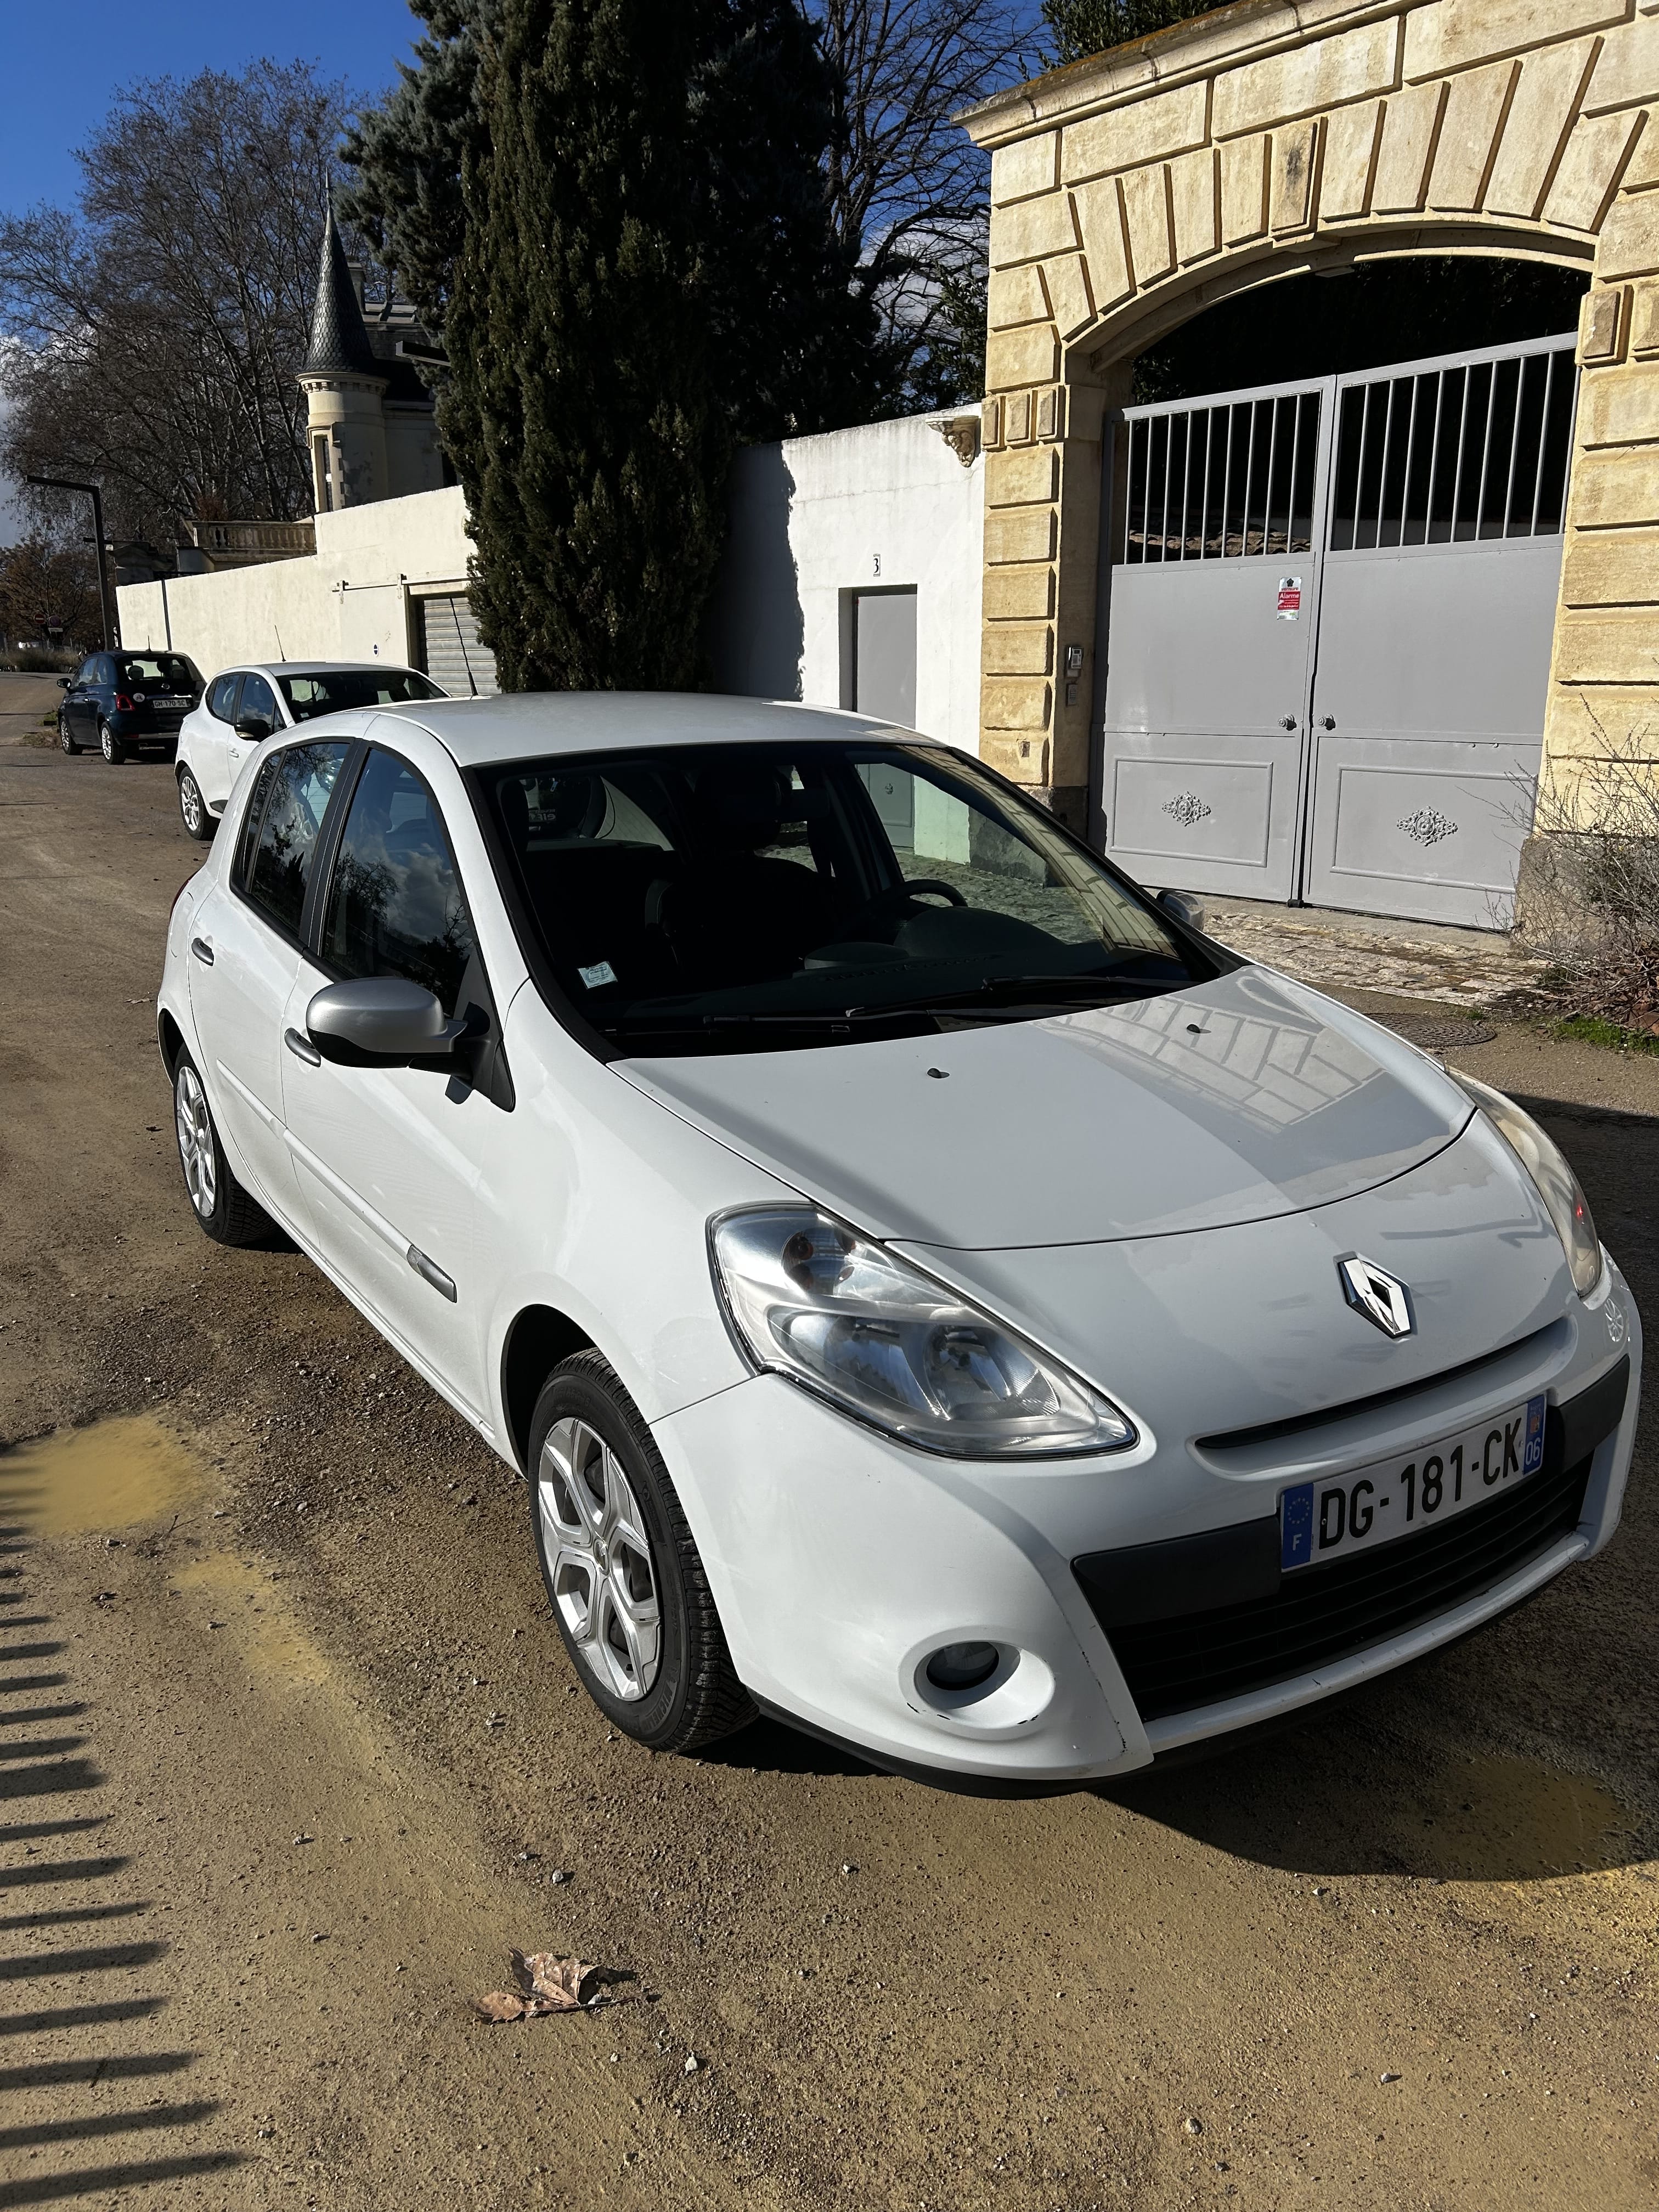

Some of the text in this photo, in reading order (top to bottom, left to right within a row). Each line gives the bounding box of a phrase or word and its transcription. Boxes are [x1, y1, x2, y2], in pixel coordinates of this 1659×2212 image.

[873, 558, 879, 573] 3
[1525, 1437, 1541, 1465] 06
[1318, 1417, 1522, 1550] DG-181-CK
[1293, 1533, 1302, 1551] F
[640, 1682, 674, 1733] MICHELIN
